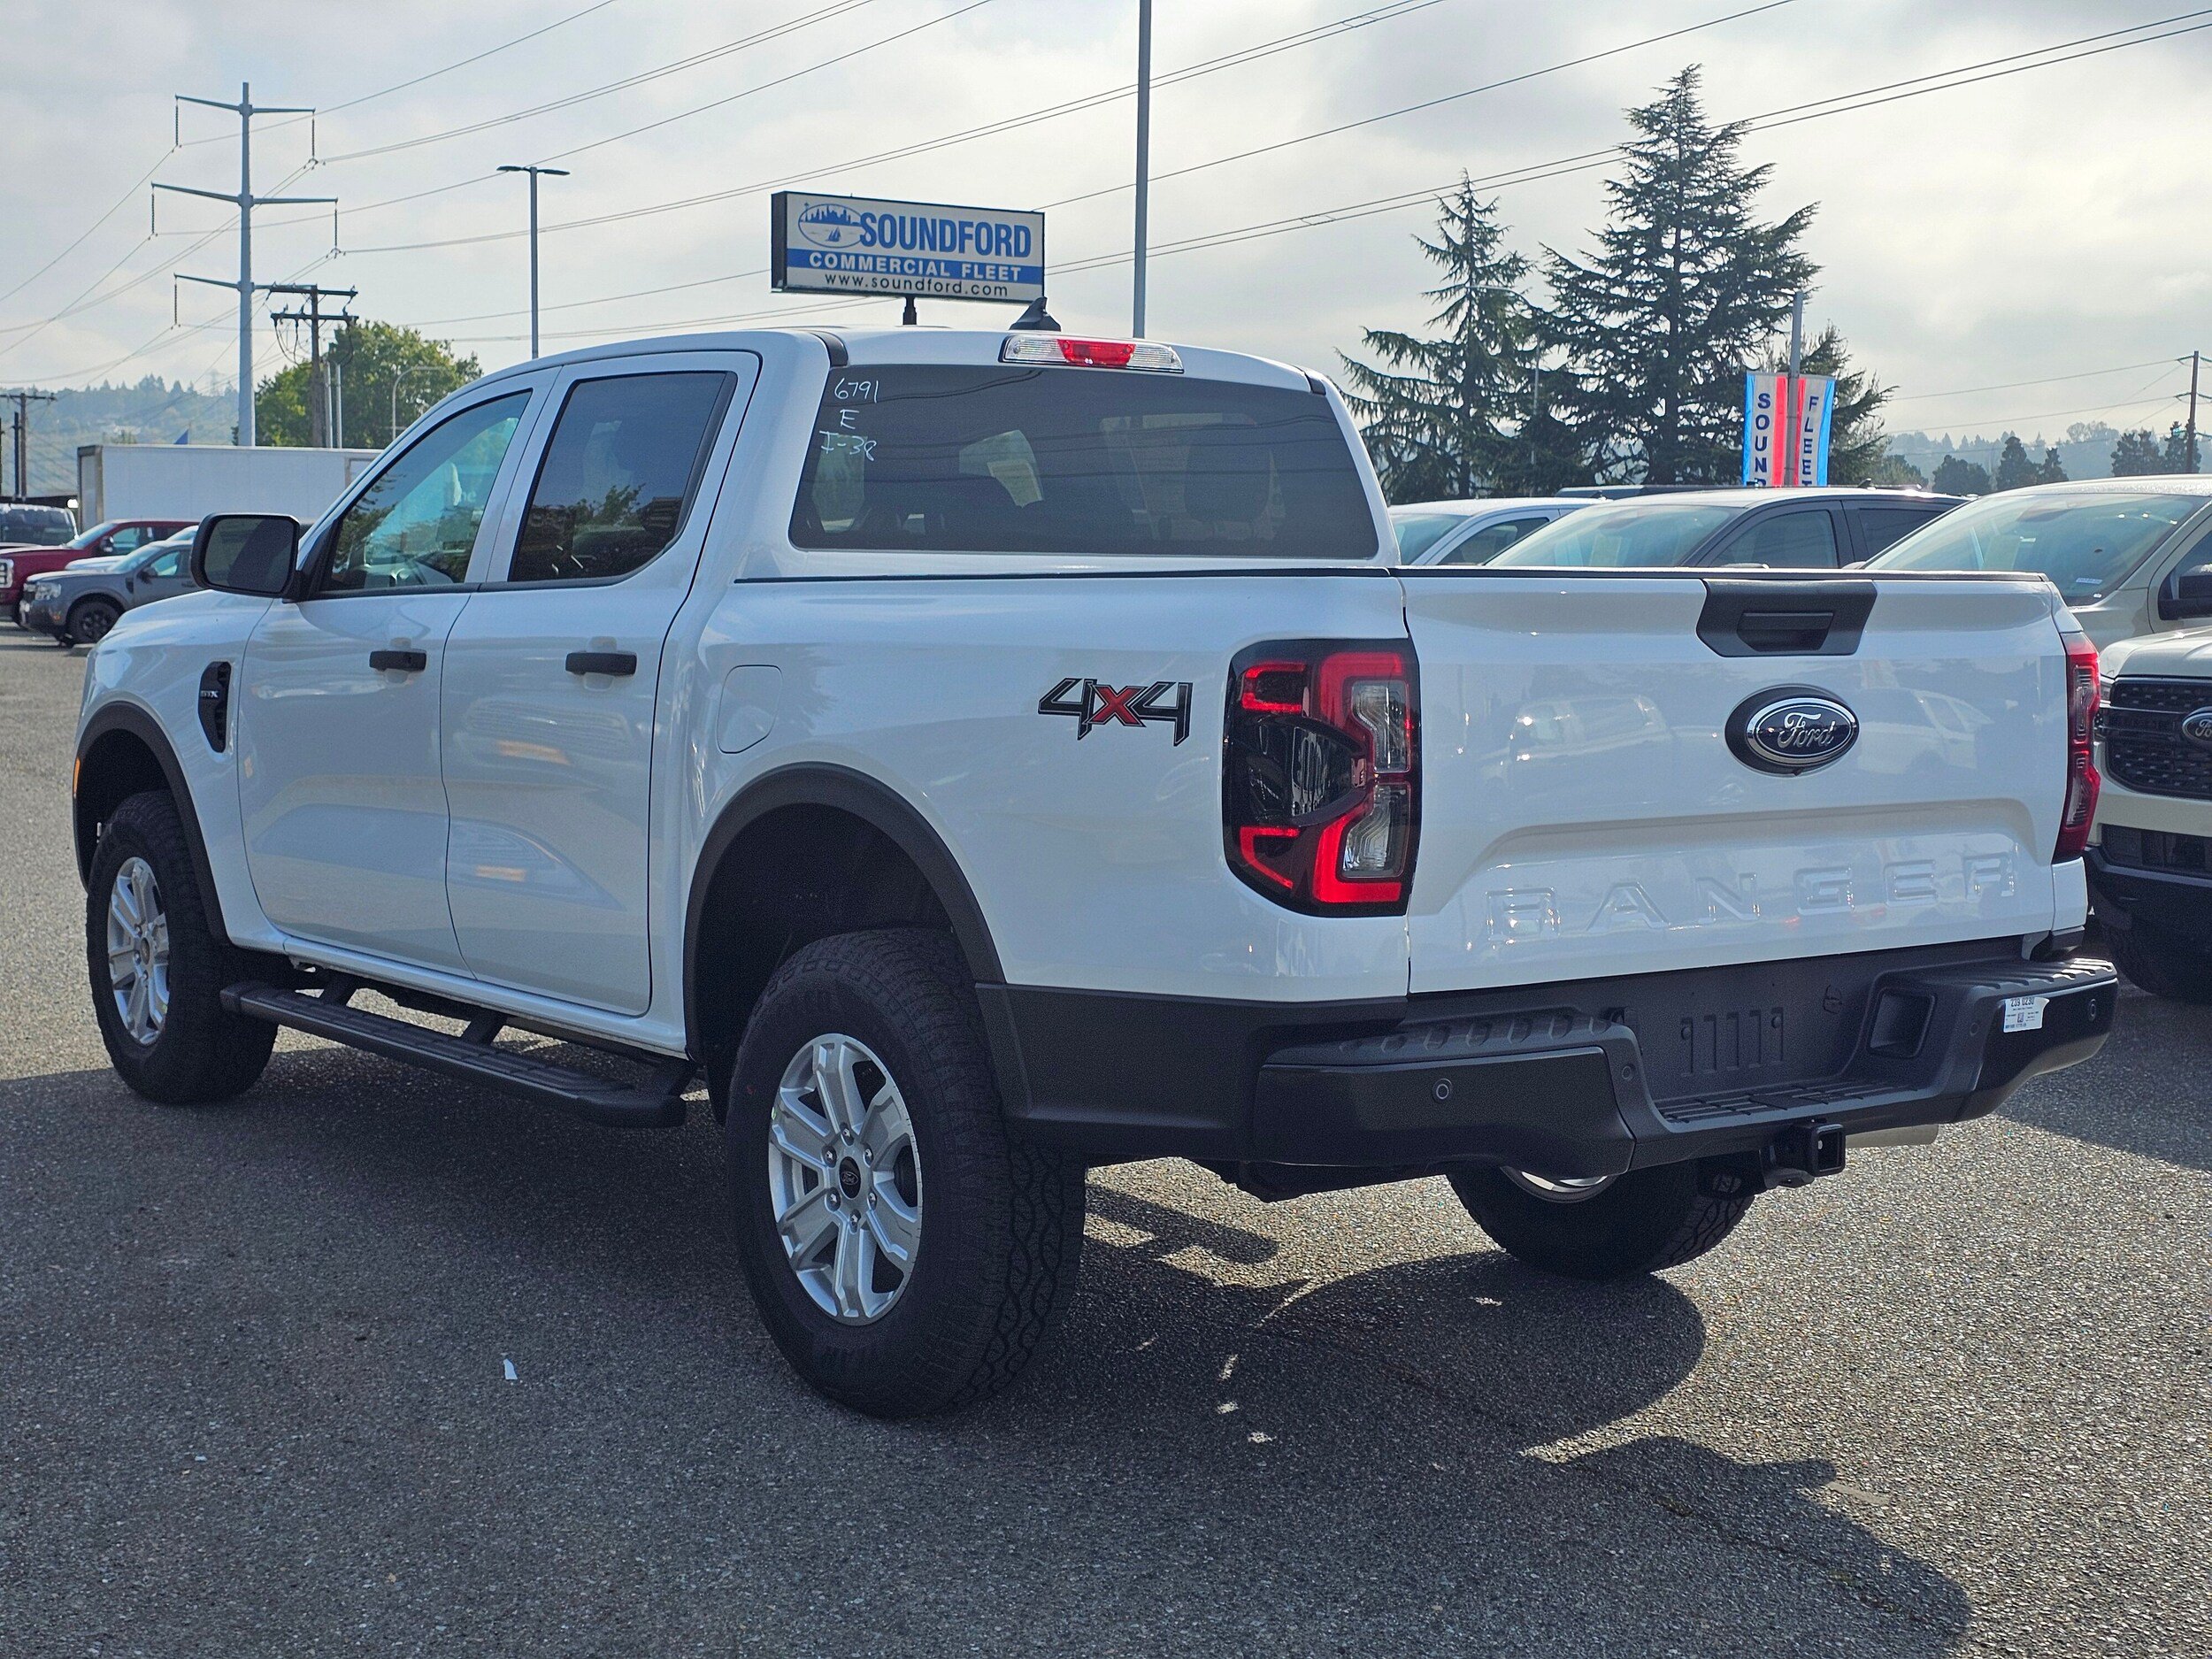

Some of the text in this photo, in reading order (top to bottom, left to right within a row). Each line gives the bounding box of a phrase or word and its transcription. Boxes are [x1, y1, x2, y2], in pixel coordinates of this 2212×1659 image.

[859, 211, 1031, 258] SOUNDFORD
[809, 251, 1021, 281] COMMERCIAL FLEET
[825, 273, 1008, 297] www.soundford.com
[834, 377, 879, 403] 6791
[840, 409, 860, 429] E
[1777, 712, 1836, 749] Ford
